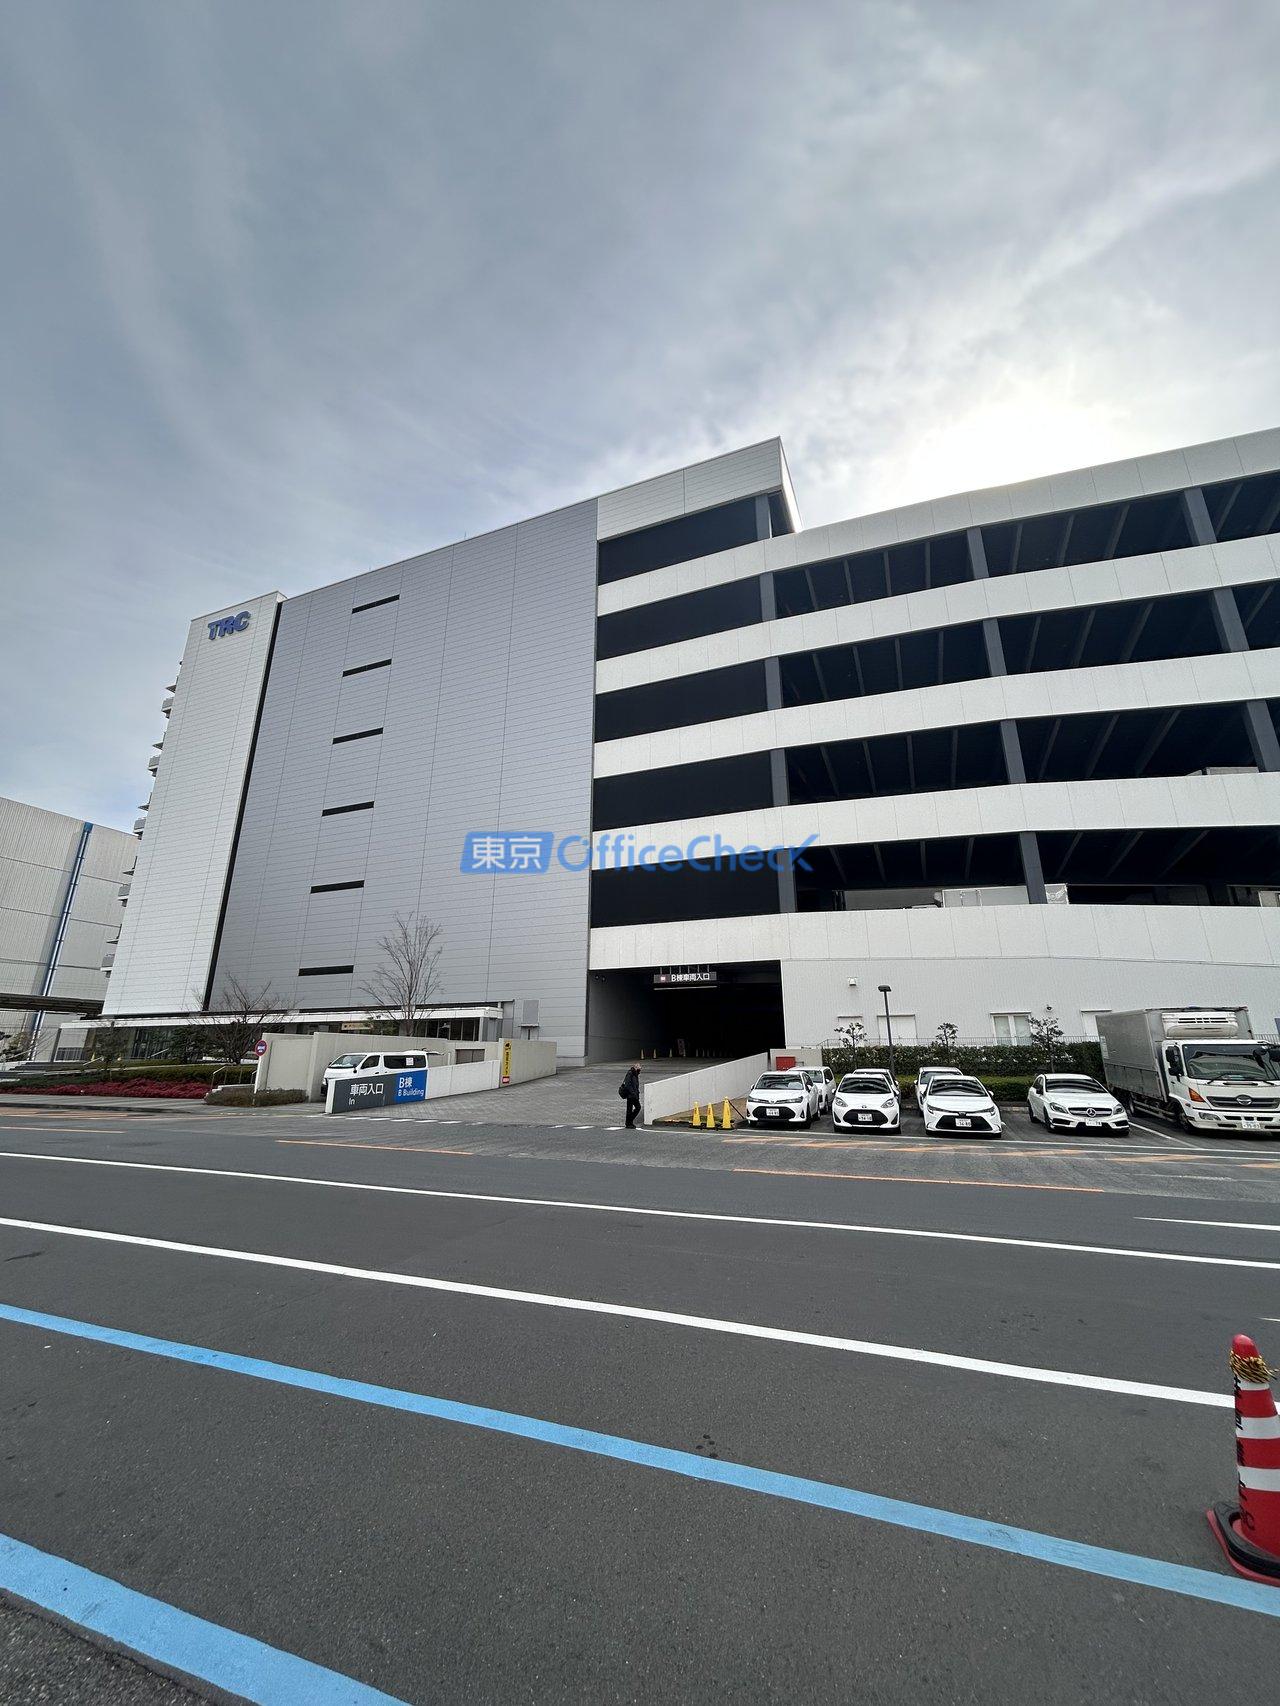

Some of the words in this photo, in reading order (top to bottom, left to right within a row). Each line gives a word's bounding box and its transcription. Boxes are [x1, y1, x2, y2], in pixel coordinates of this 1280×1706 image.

[208, 611, 251, 640] TRC
[399, 1077, 412, 1088] B棟
[350, 1083, 384, 1096] 車両入口
[404, 1088, 424, 1096] Building
